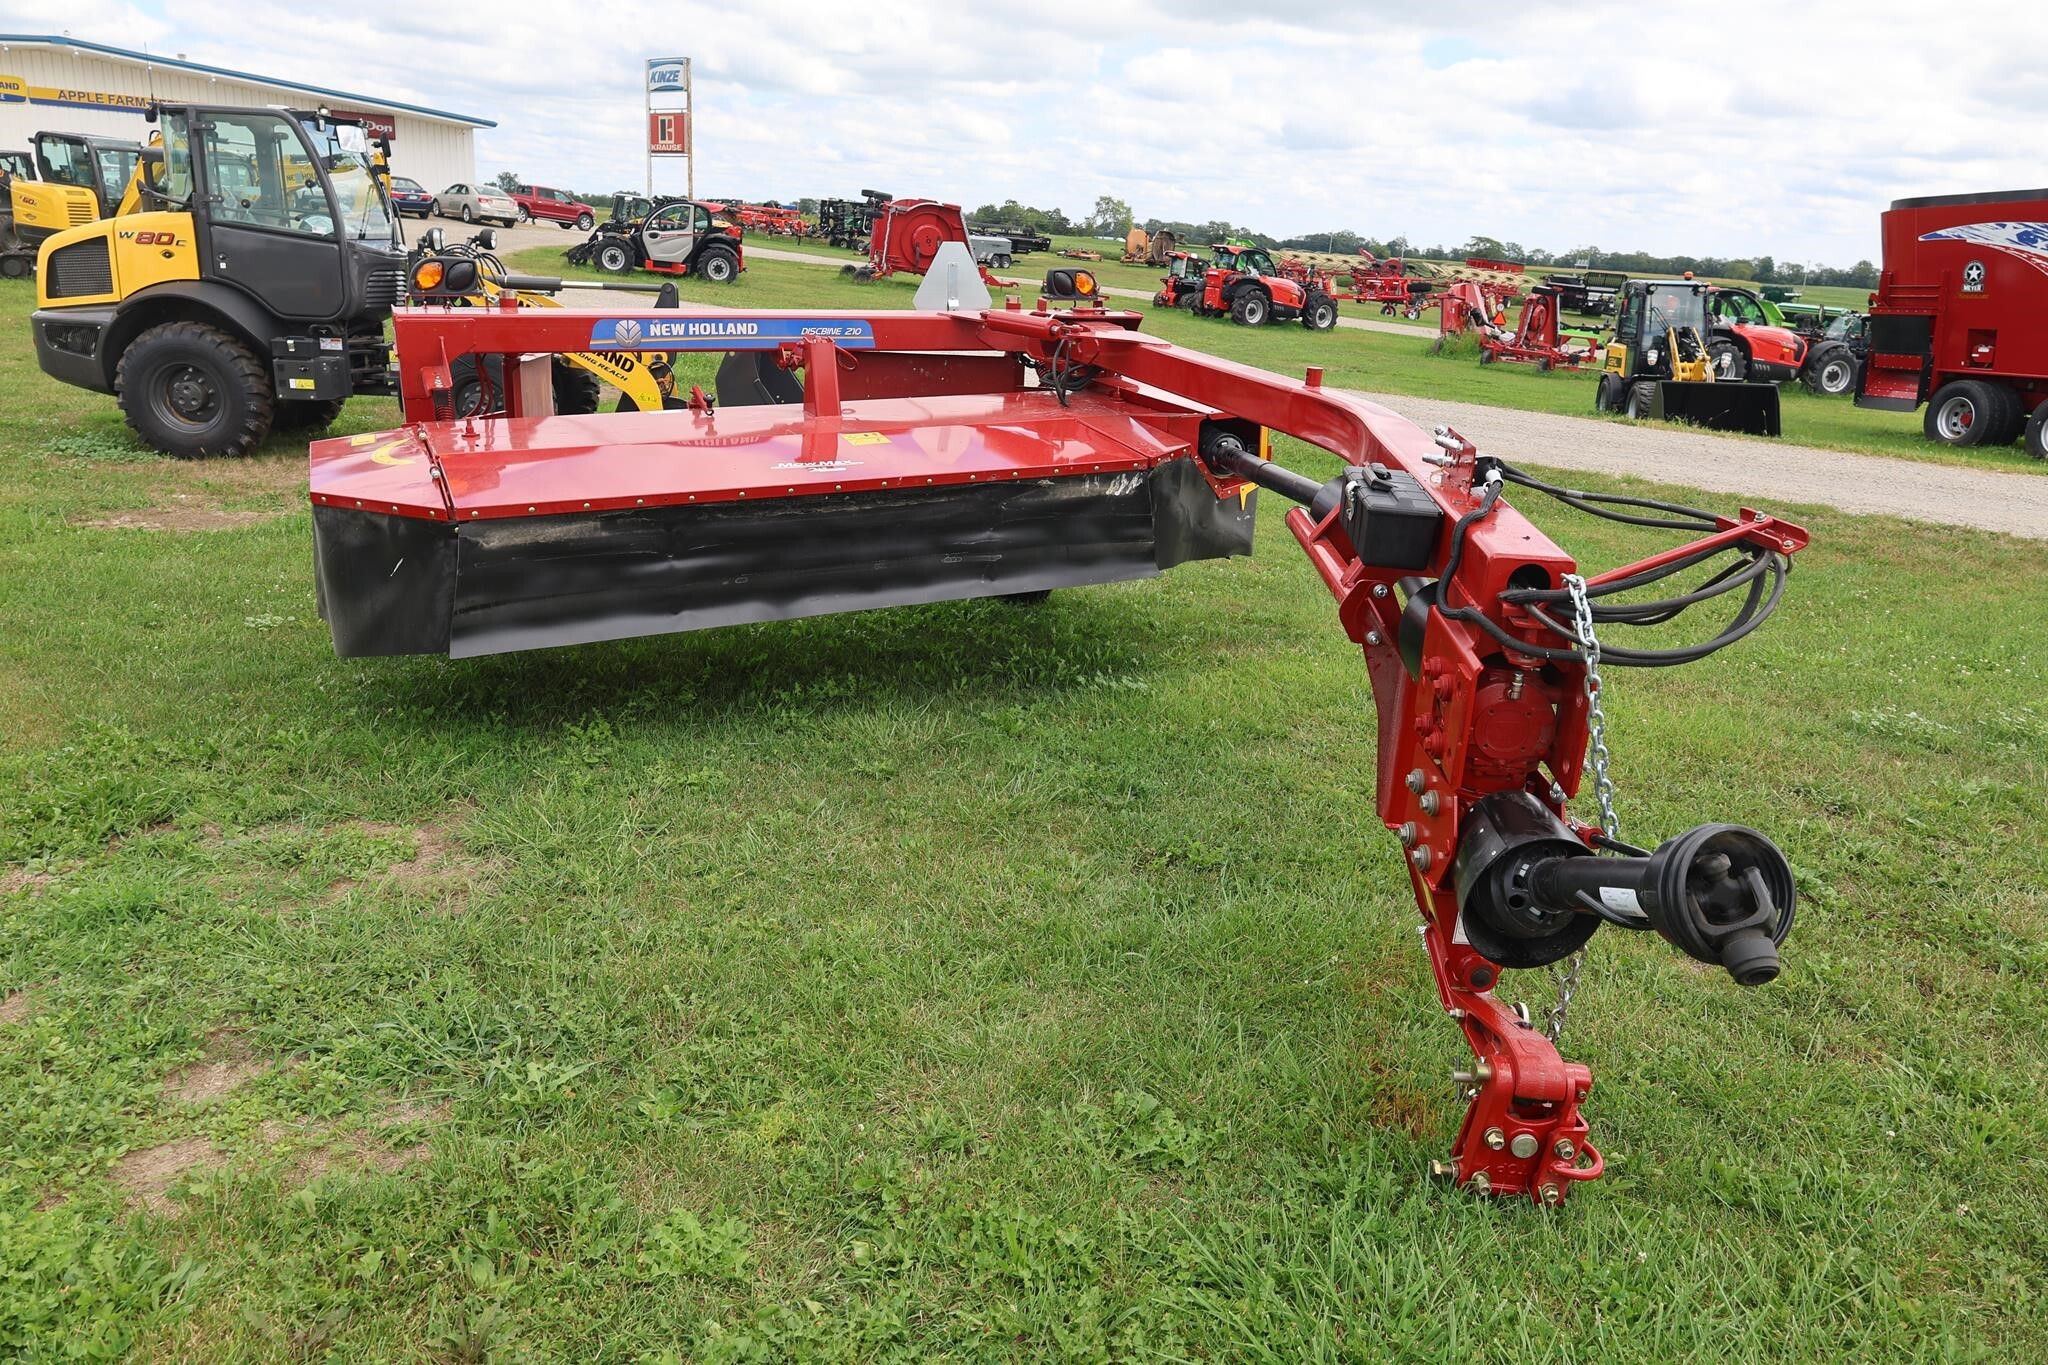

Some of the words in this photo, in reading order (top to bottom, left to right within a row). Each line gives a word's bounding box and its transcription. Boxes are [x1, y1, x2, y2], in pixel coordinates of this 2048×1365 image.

[650, 70, 681, 83] KINZE
[58, 90, 105, 104] APPLE
[108, 94, 147, 108] FARM
[651, 143, 682, 151] KRAUSE
[651, 323, 685, 337] NEW
[688, 323, 758, 336] HOLLAND
[801, 327, 843, 336] DISCBINE
[845, 327, 862, 336] 210
[598, 363, 628, 382] REACH
